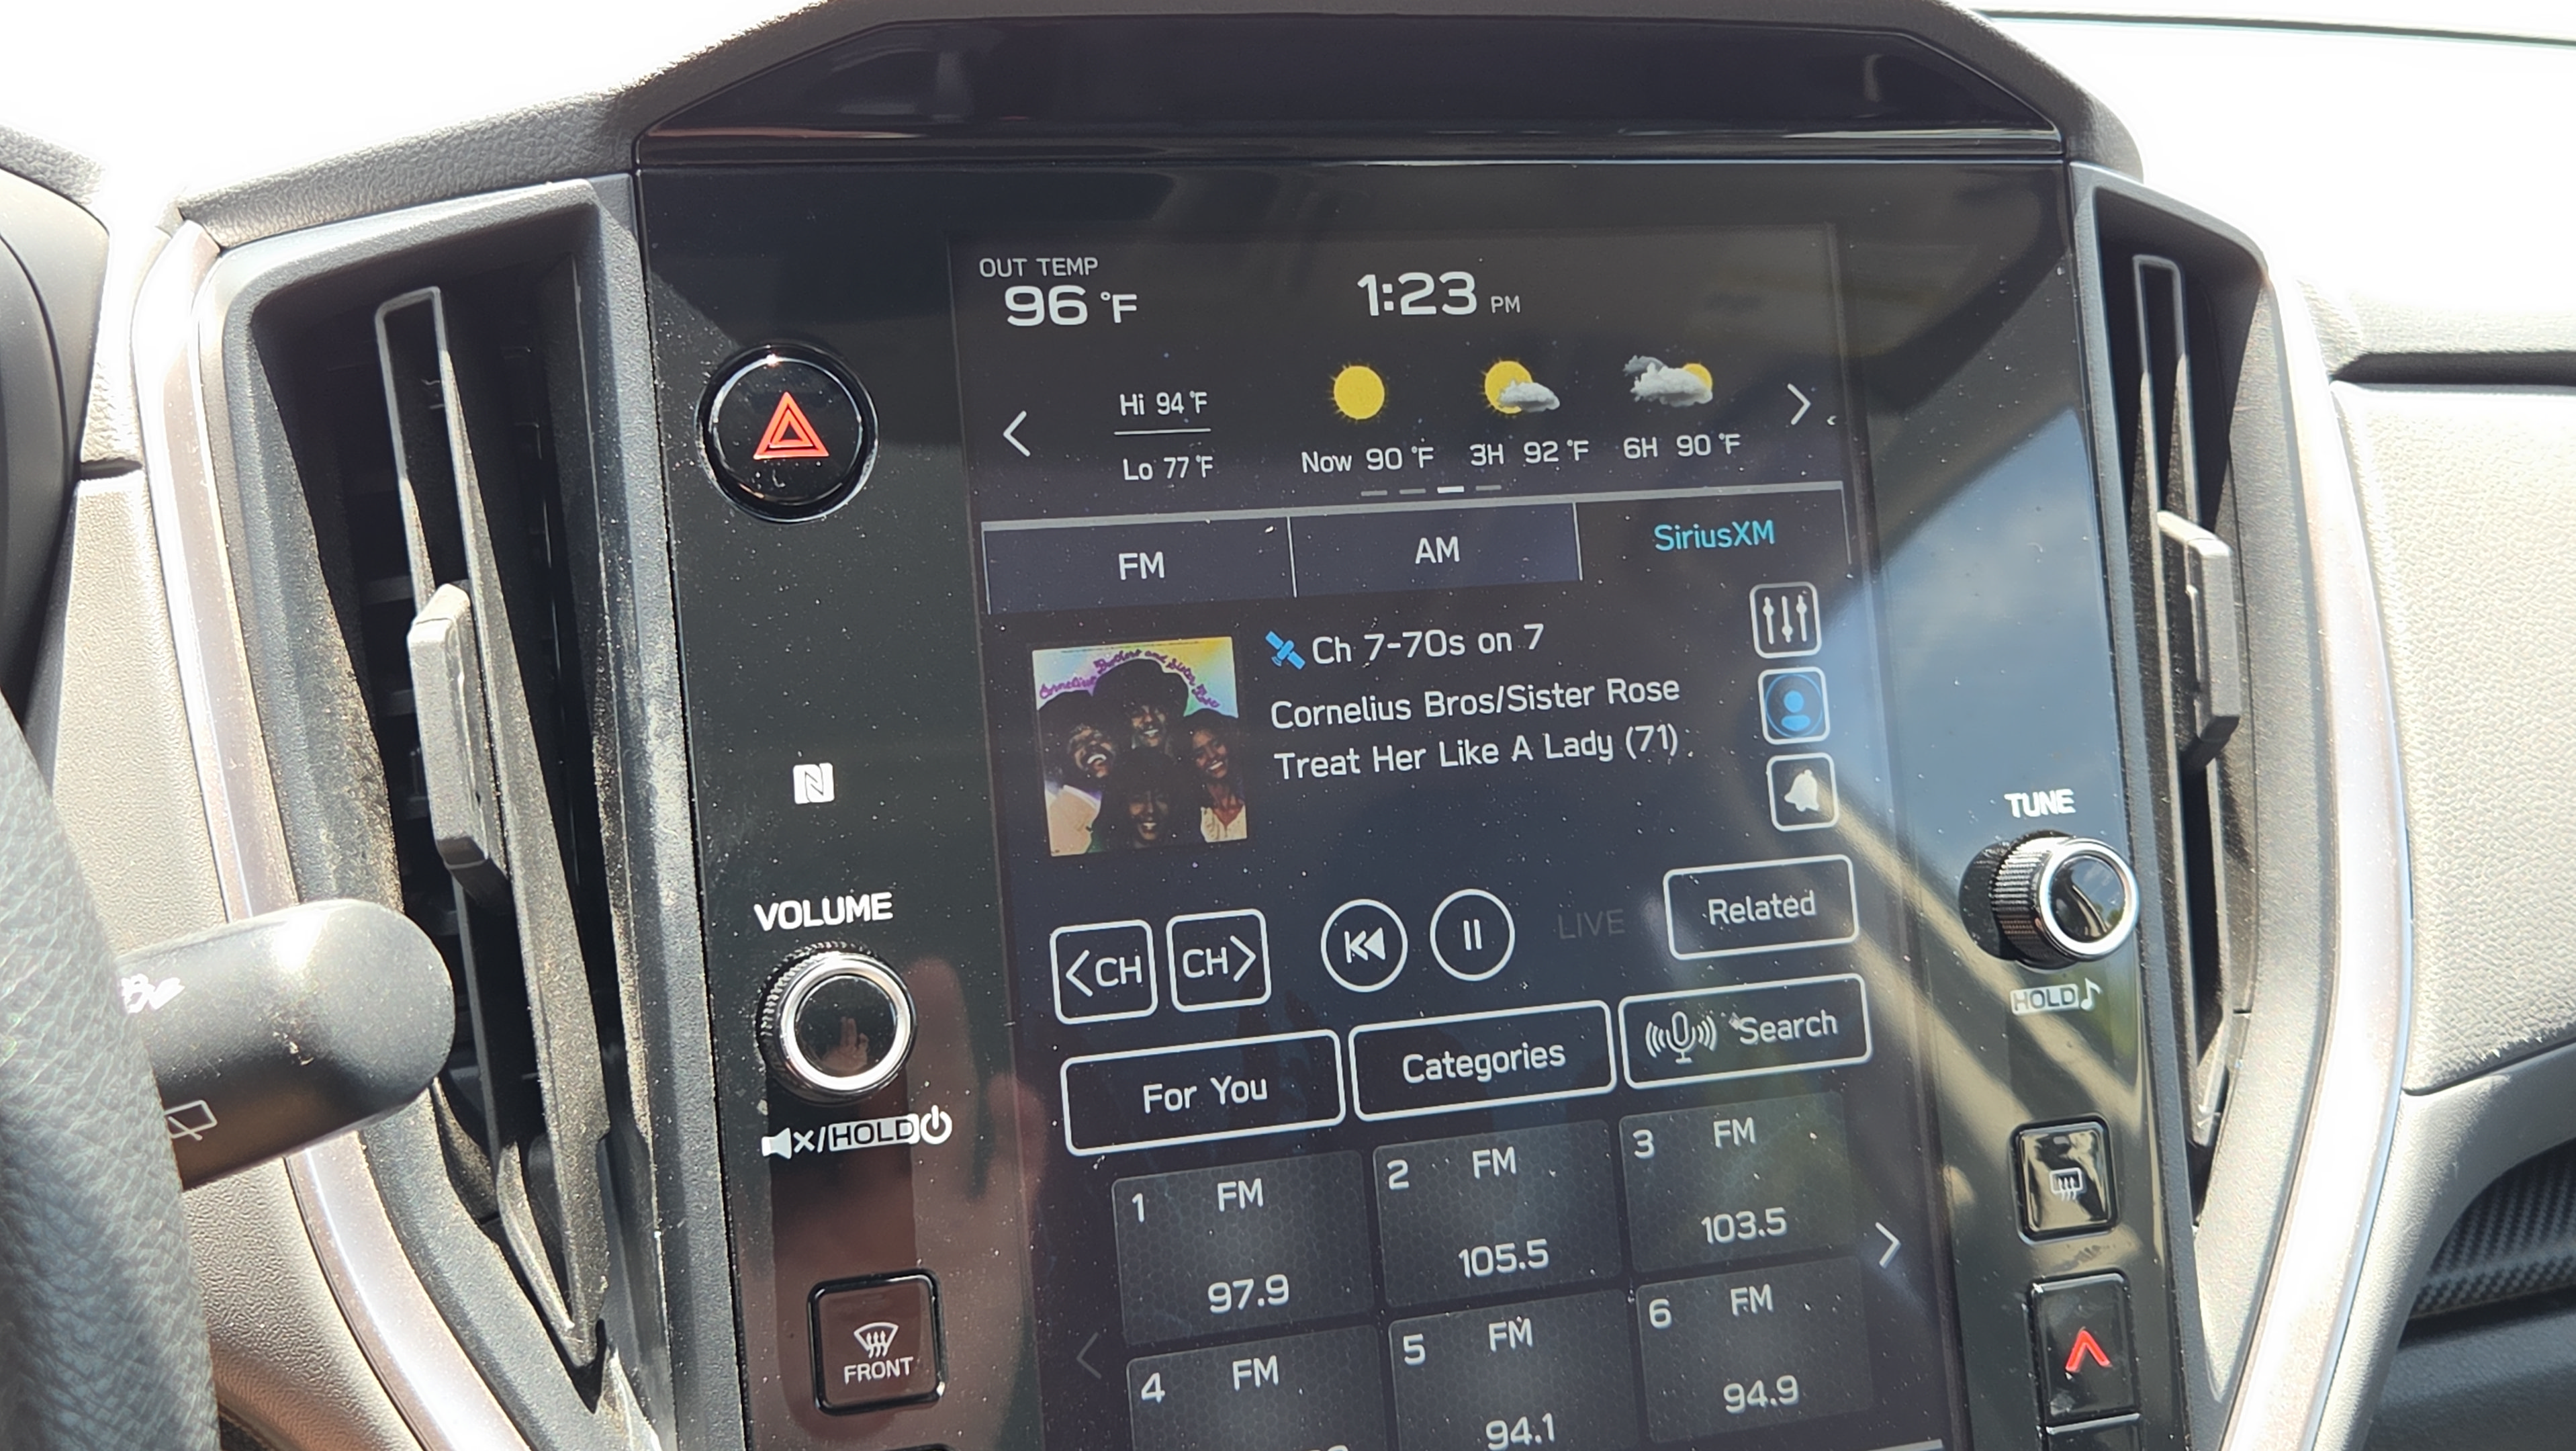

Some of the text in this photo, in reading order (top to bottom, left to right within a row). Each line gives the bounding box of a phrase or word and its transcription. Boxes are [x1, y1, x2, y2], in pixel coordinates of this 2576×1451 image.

[979, 257, 1098, 277] OUT TEMP
[1005, 285, 1088, 326] 96
[1357, 271, 1520, 316] 1:23 PM
[1119, 393, 1145, 416] Hi
[1301, 451, 1352, 474] Now
[1366, 447, 1403, 471] 90
[1469, 443, 1504, 466] 3H
[1524, 441, 1559, 464] 92
[1623, 437, 1658, 459] 6H
[1676, 434, 1711, 457] 90
[1123, 458, 1153, 480] Lo
[1415, 536, 1460, 564] AM
[1654, 519, 1775, 551] SiriusXM
[1118, 552, 1165, 580] FM
[1312, 623, 1544, 664] Ch 7-70s on 7
[1271, 678, 1680, 729] Cornelius Bros/Sister Rose
[1273, 723, 1678, 780] Treat Her Like A Lady (71)
[2004, 789, 2076, 818] TUNE
[753, 891, 893, 931] VOLUME
[1557, 909, 1626, 939] LIVE
[1708, 889, 1816, 926] Related
[1095, 955, 1142, 987] CH
[1183, 947, 1228, 978] CH
[2015, 986, 2076, 1012] HOLD
[1739, 1009, 1838, 1045] Search
[1403, 1042, 1566, 1084] Categories
[1143, 1075, 1268, 1114] For You
[832, 1118, 915, 1148] HOLD
[1632, 1117, 1756, 1159] 3 FM
[1387, 1146, 1516, 1190] 2 FM
[1132, 1178, 1264, 1223] 1 FM
[1701, 1206, 1787, 1244] 103.5
[1458, 1239, 1549, 1278] 105.5
[1207, 1274, 1289, 1313] 97.9
[1649, 1284, 1773, 1329] 6 FM
[1403, 1316, 1533, 1365] 5 FM
[844, 1356, 914, 1384] FRONT
[1141, 1355, 1279, 1403] 4 FM
[1723, 1375, 1798, 1413] 94.9
[1485, 1413, 1555, 1451] 94.1
